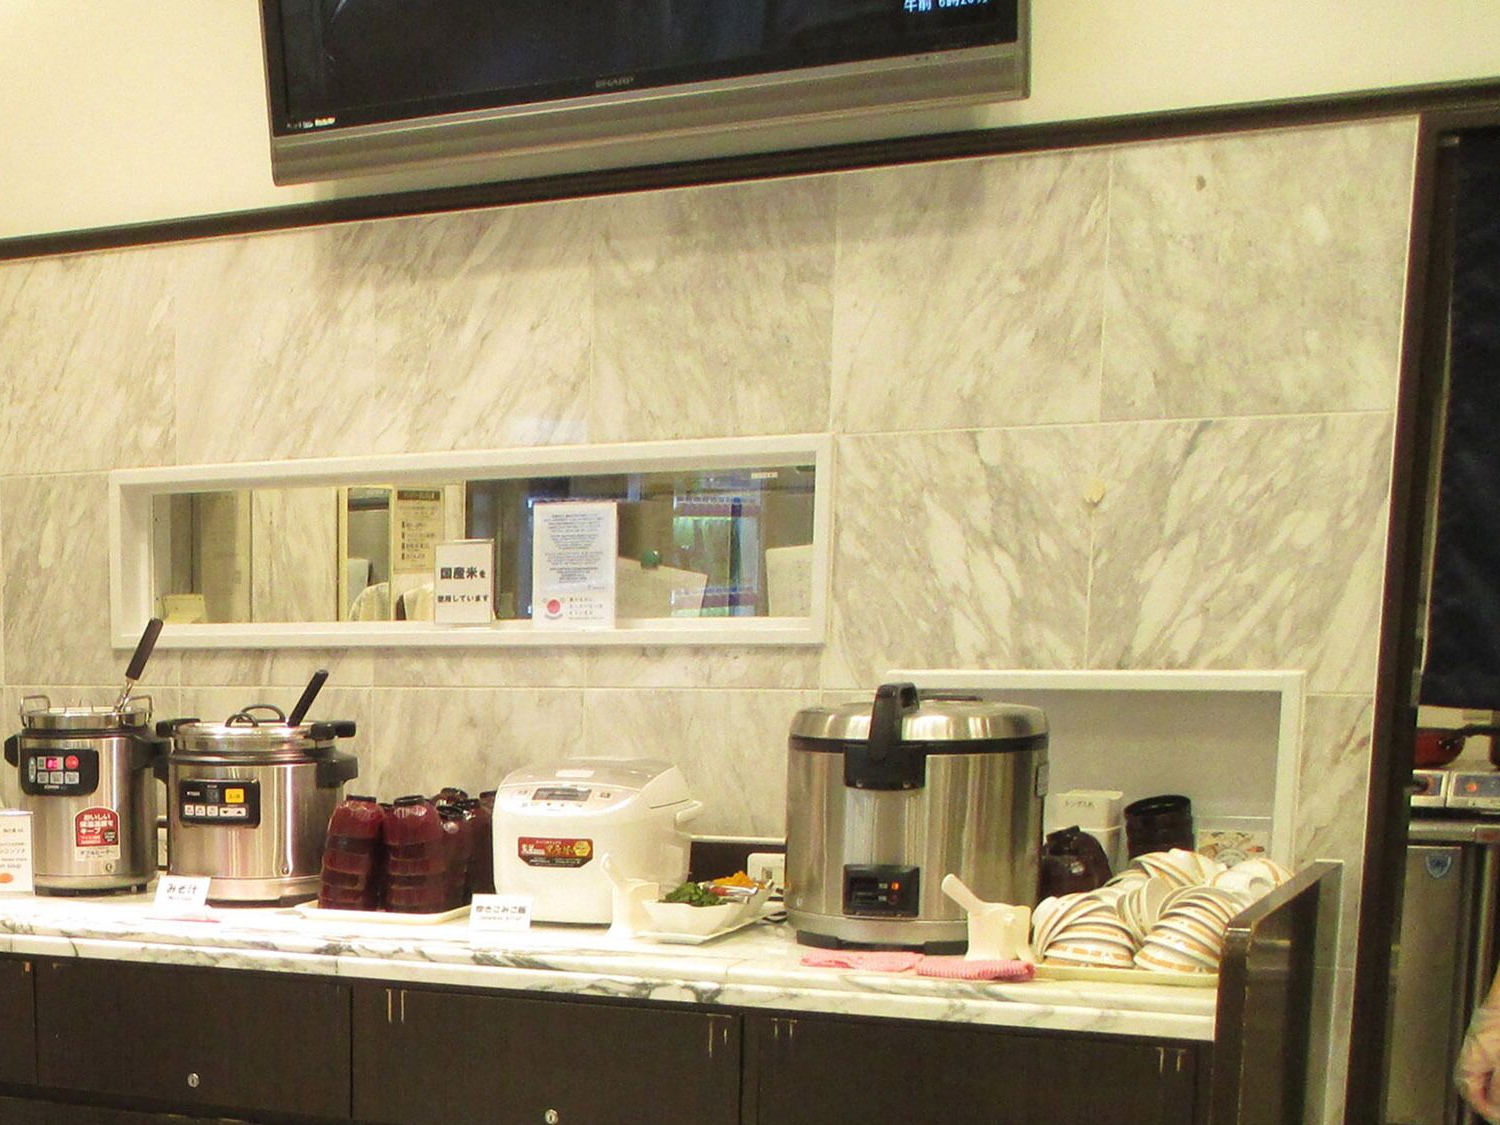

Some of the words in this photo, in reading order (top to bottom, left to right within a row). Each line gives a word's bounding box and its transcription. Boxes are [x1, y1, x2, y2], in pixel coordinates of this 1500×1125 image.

[440, 567, 485, 579] 国産米を
[437, 594, 489, 603] 使用しています
